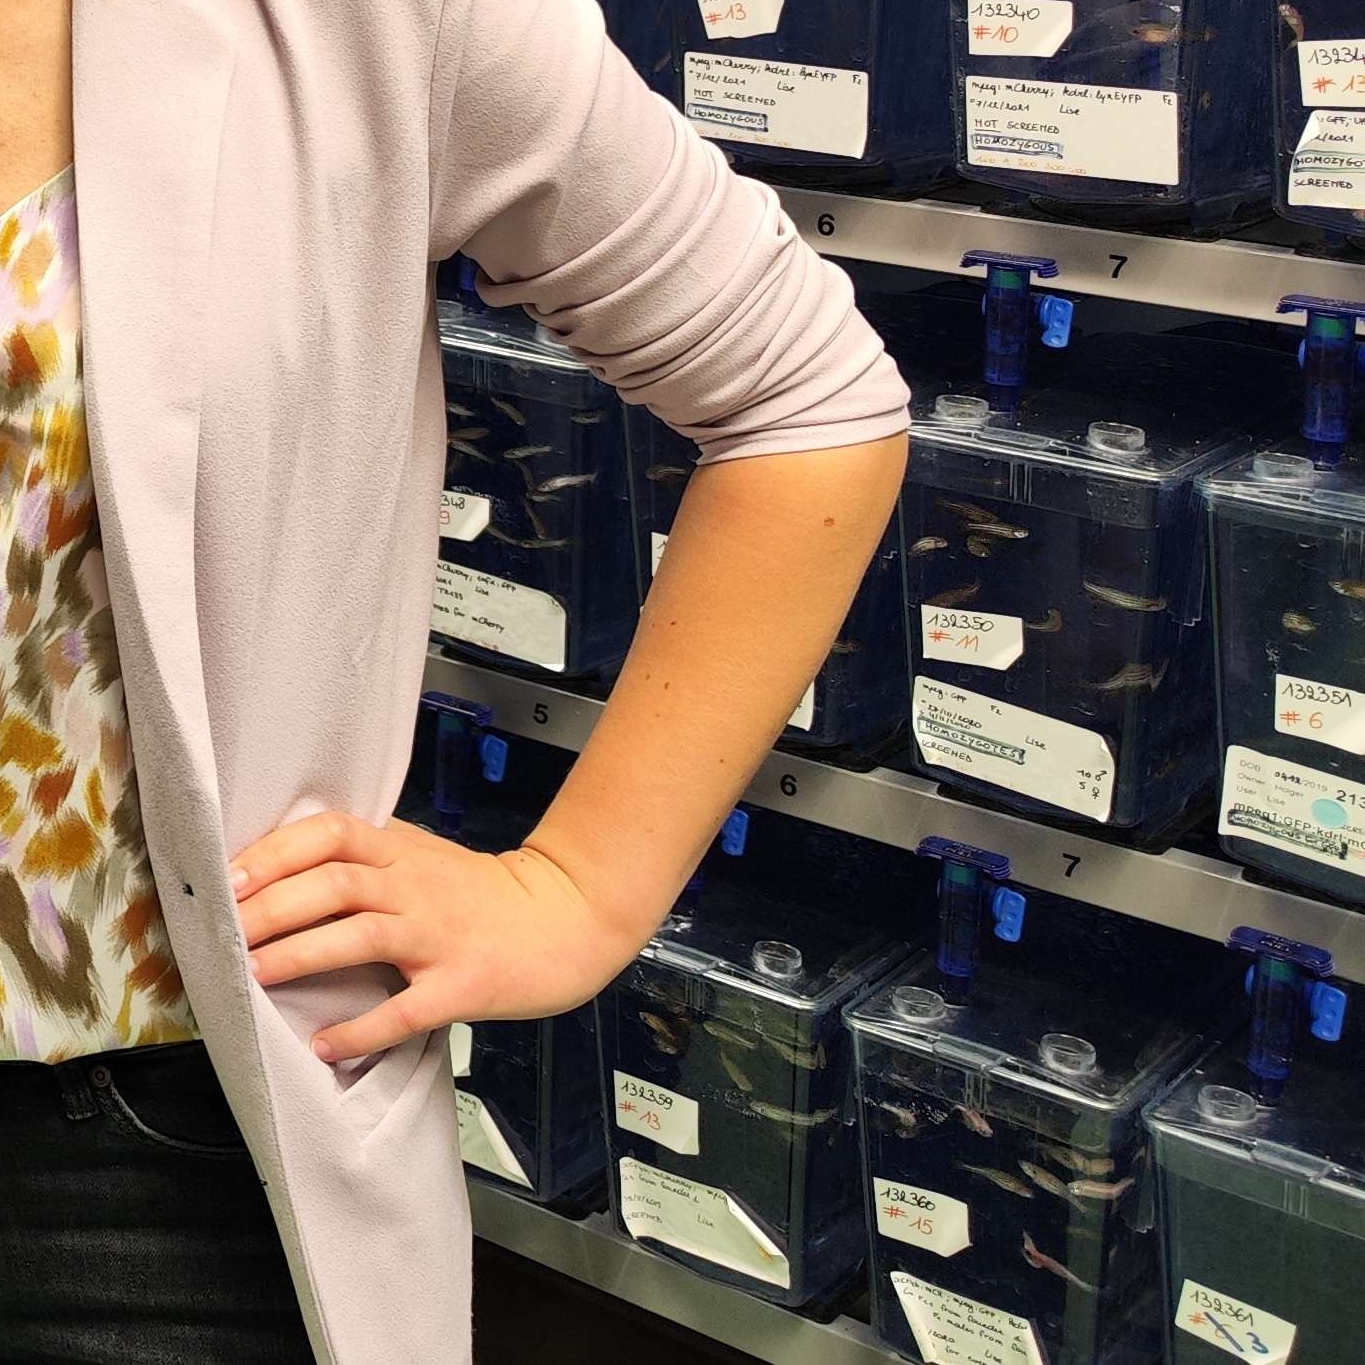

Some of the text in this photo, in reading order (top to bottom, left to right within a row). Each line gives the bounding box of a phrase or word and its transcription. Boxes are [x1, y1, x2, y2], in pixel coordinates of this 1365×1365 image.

[971, 3, 1041, 21] 132340
[777, 81, 795, 93] Lise
[693, 88, 777, 106] NOT SCREENED
[694, 108, 764, 126] HOMOZYGOUS
[1059, 104, 1080, 115] Lise
[974, 118, 1061, 134] NOT SCREENED
[975, 136, 1055, 152] HOMOZYGOUS
[1294, 178, 1353, 189] SCREENED
[817, 214, 835, 235] 6
[1109, 255, 1128, 279] 7
[926, 613, 995, 632] 132350
[1281, 682, 1352, 708] 132351
[533, 704, 548, 725] 5
[925, 721, 1017, 758] HOMOZYGOTES
[1025, 736, 1047, 750] Lise
[1076, 770, 1092, 779] 10
[1239, 760, 1261, 772] DOB
[780, 773, 797, 796] 6
[1237, 772, 1266, 785] Owner
[1236, 785, 1286, 805] User Lise
[1063, 855, 1081, 878] 7
[620, 1080, 674, 1111] 132359
[880, 1187, 936, 1211] 132360
[1190, 1290, 1254, 1326] 132361
